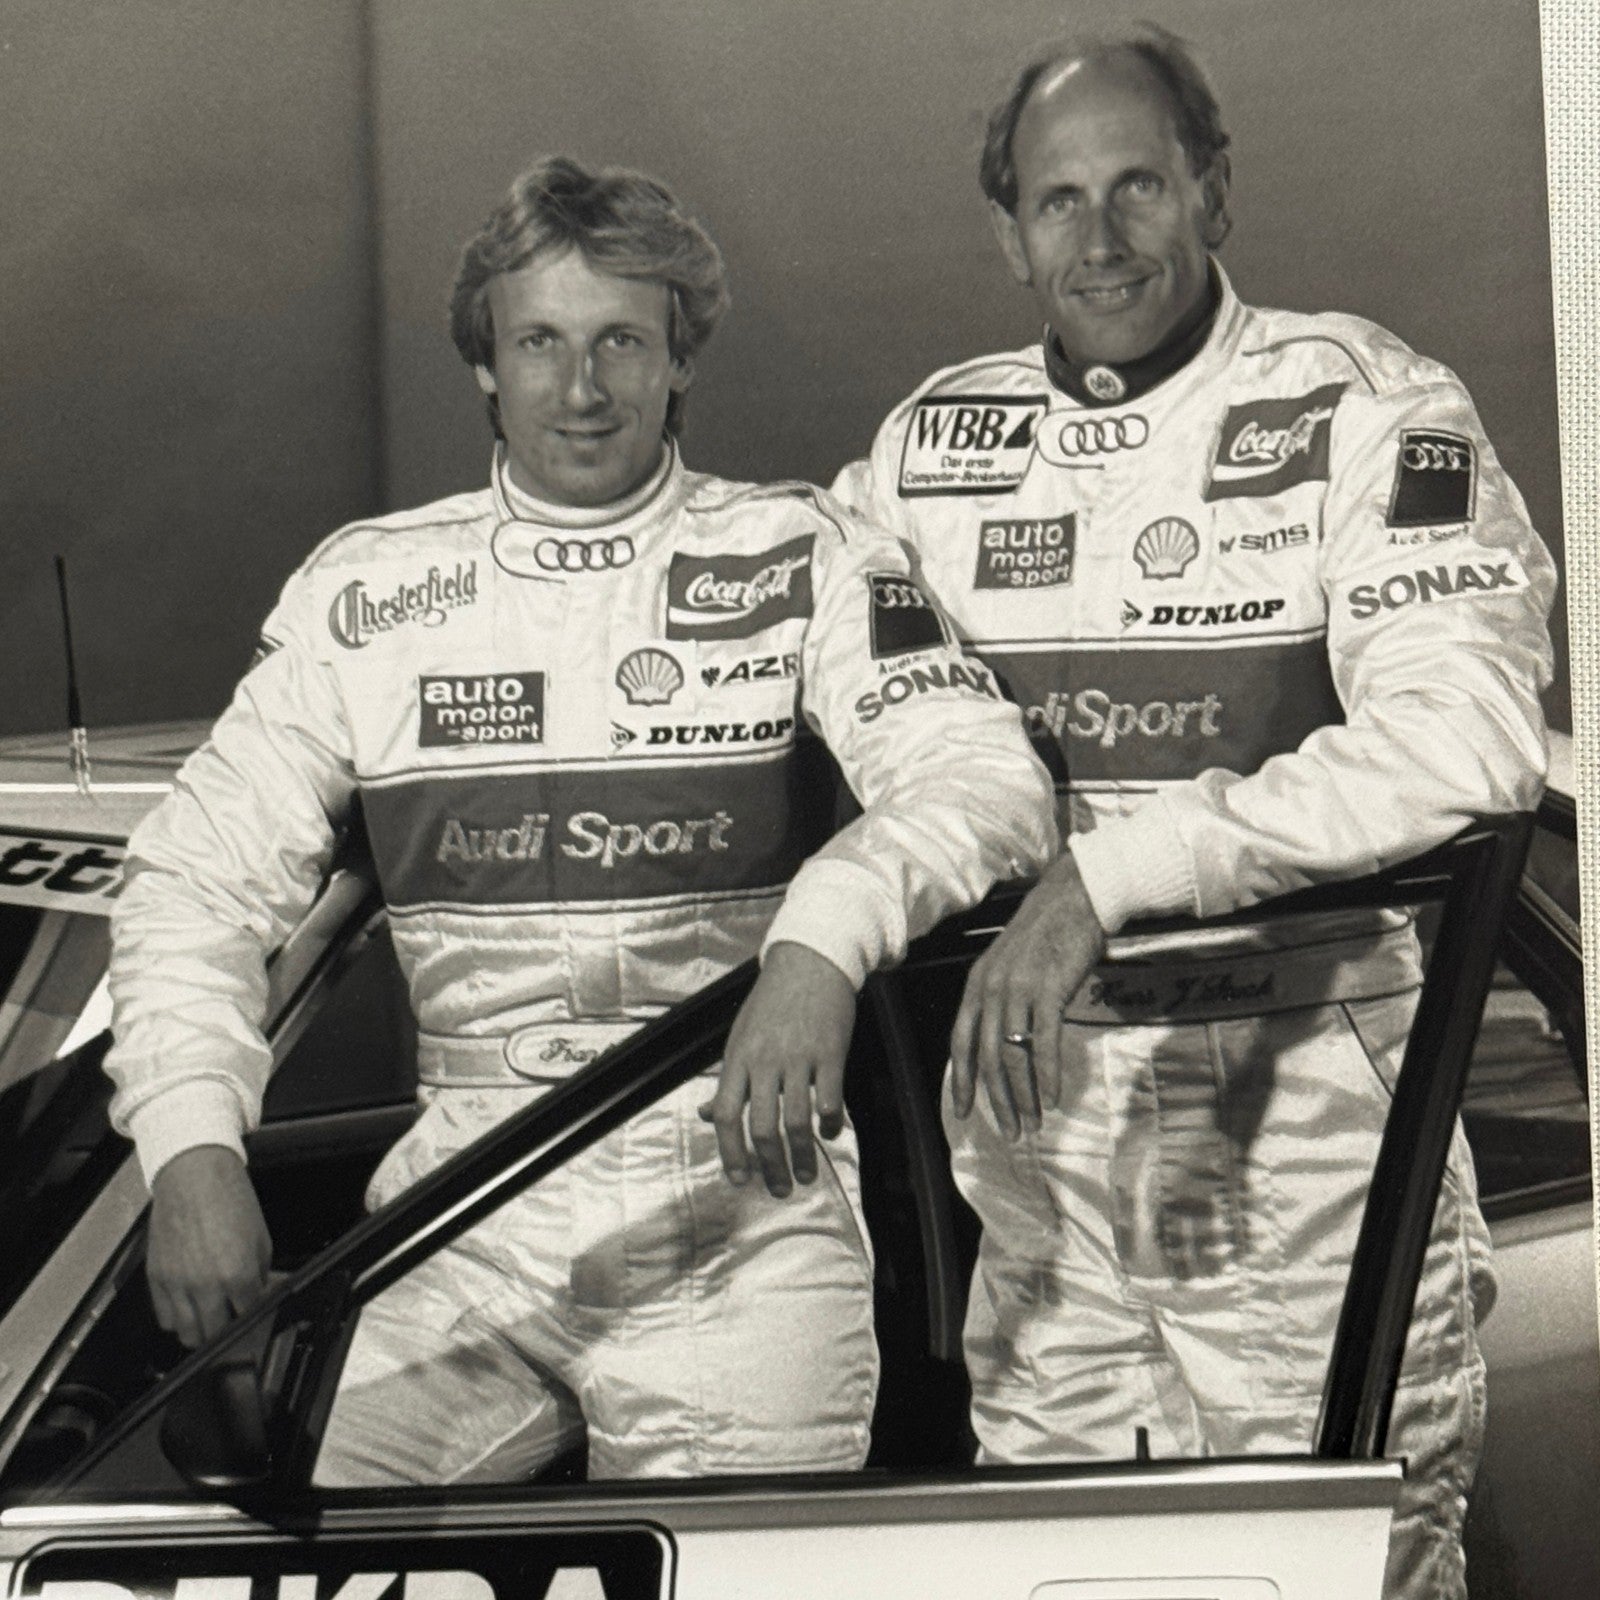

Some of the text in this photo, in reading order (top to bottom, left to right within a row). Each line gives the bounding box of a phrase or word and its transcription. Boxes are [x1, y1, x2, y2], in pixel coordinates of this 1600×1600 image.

[918, 407, 1007, 450] WBB
[983, 521, 1064, 549] auto
[988, 547, 1069, 569] motor
[327, 559, 478, 650] Chesterfield
[1348, 563, 1518, 620] SONAX
[1148, 598, 1286, 626] DUNLOP
[423, 677, 524, 704] auto
[854, 662, 998, 724] SONAX
[437, 703, 535, 726] motor
[646, 717, 794, 746] DUNLOP
[1067, 688, 1223, 749] Sport
[436, 809, 734, 869] Audi Sport
